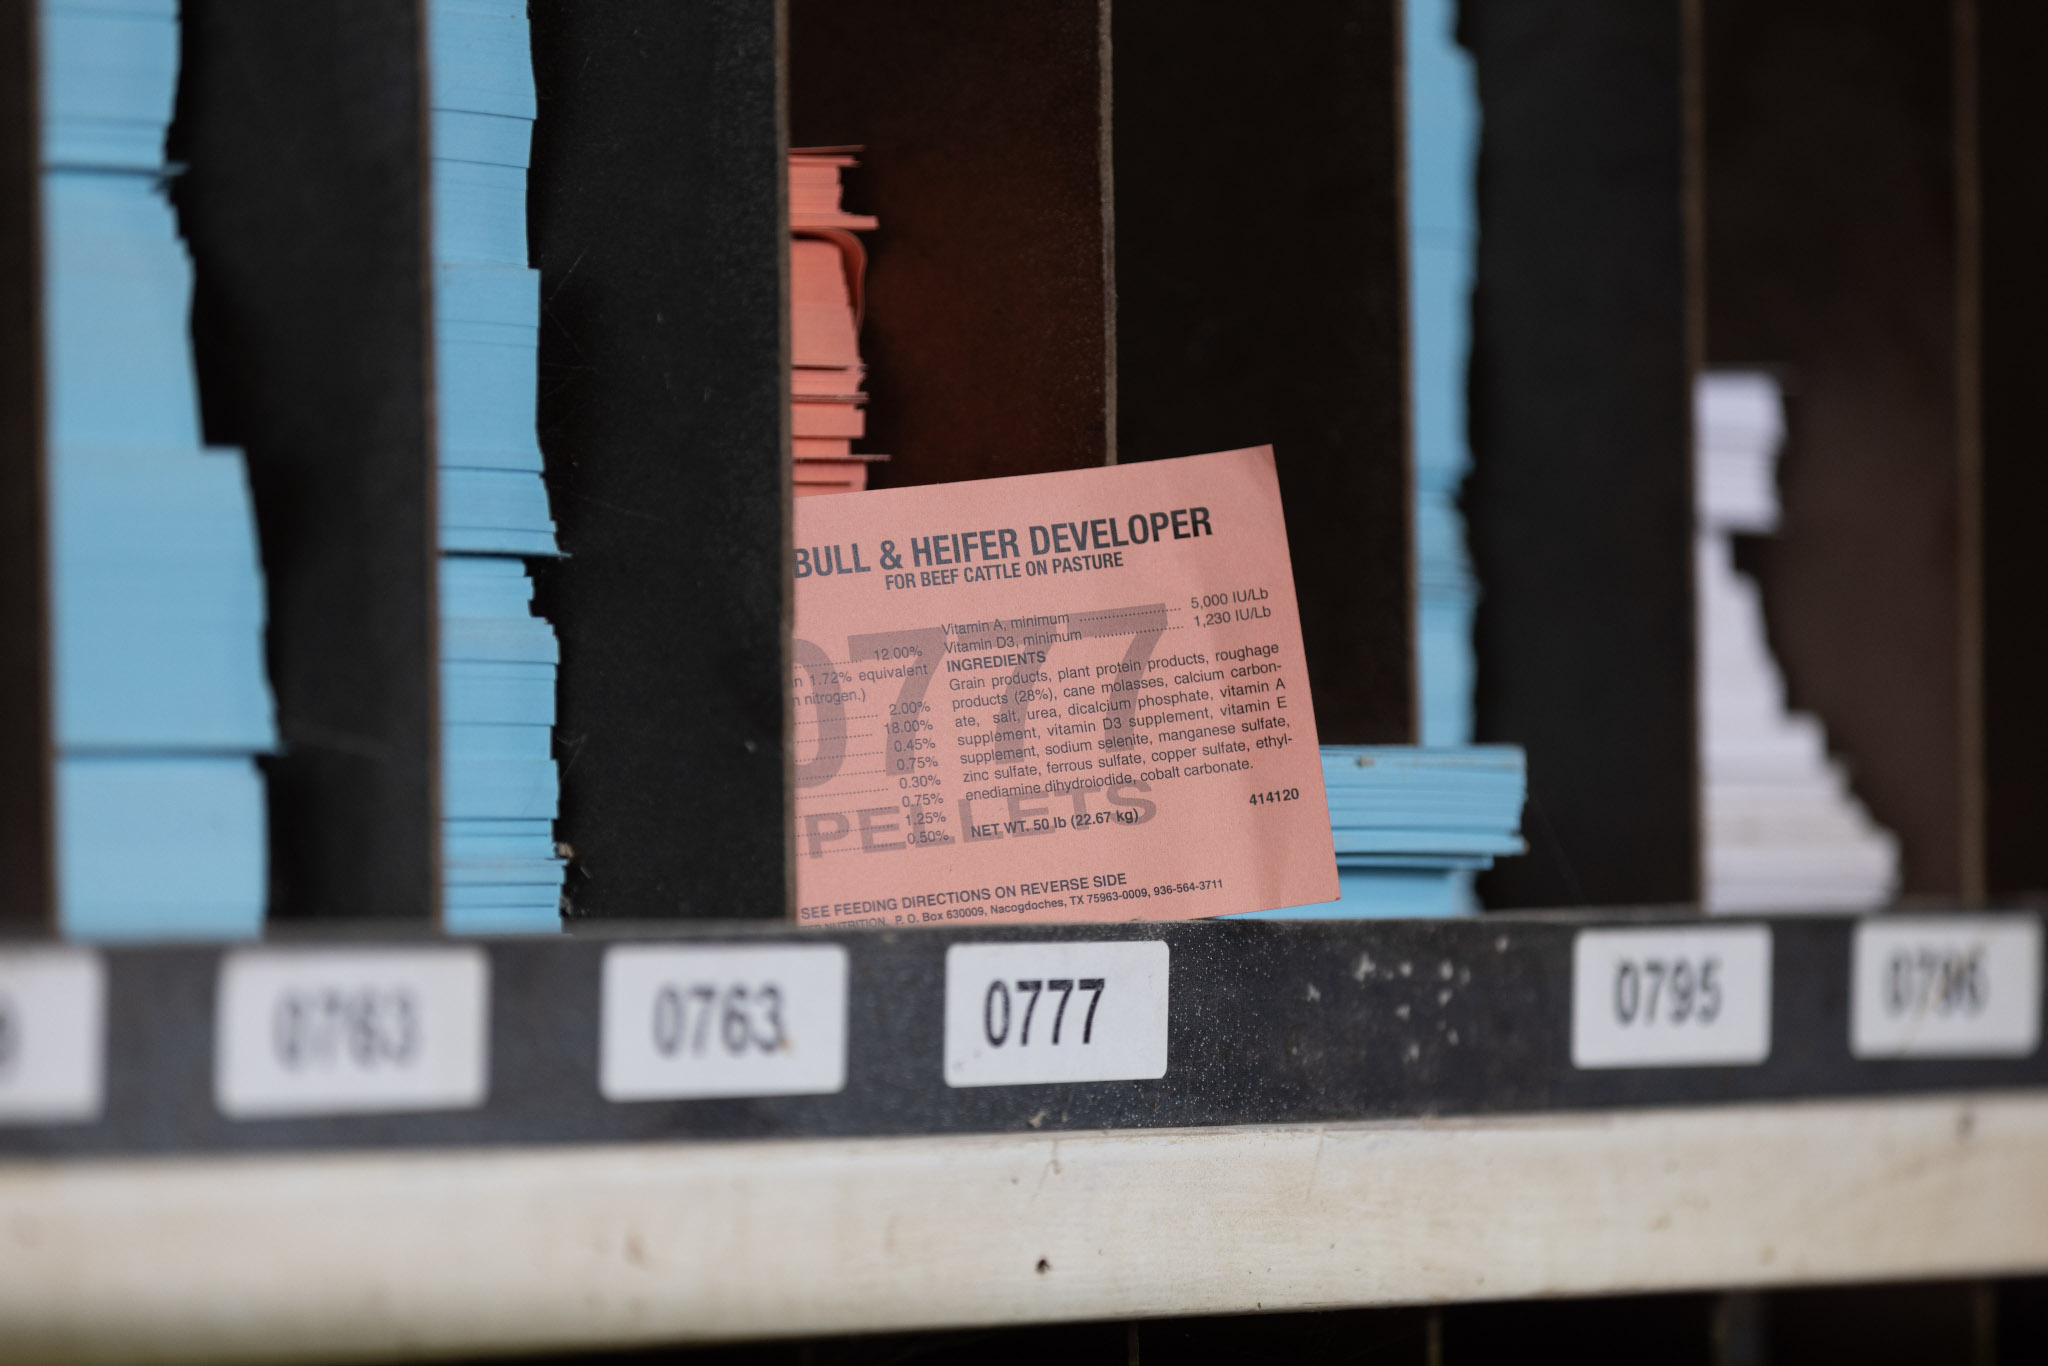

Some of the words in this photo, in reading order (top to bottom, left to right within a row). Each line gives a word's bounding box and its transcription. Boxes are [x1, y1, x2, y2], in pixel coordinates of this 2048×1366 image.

[794, 543, 871, 578] BULL
[879, 540, 902, 570] &
[911, 528, 1020, 567] HEIFER
[1029, 506, 1213, 557] DEVELOPER
[885, 574, 916, 590] FOR
[921, 569, 959, 587] BEEF
[964, 562, 1021, 582] CATTLE
[1025, 561, 1048, 577] ON
[1052, 552, 1124, 574] PASTURE
[942, 622, 990, 636] Vitamin
[993, 619, 1007, 631] A,
[1011, 614, 1070, 628] minimum
[1190, 593, 1228, 609] 5,000
[1232, 588, 1269, 604] IU/Lb
[945, 639, 993, 654] Vitamin
[996, 637, 1019, 650] D3,
[1023, 630, 1082, 645] minimum
[1194, 613, 1231, 628] 1,230
[1235, 607, 1272, 622] IU/Lb
[810, 672, 852, 684] 1.72%
[858, 664, 928, 683] equivalent
[873, 646, 923, 660] 12.00%
[947, 651, 1046, 672] INGREDIENTS
[949, 677, 985, 691] Grain
[991, 671, 1052, 690] products,
[1058, 665, 1091, 682] plant
[1096, 659, 1142, 677] protein
[1148, 652, 1209, 672] products,
[1215, 644, 1279, 661] roughage
[804, 689, 867, 706] nitrogen.)
[952, 695, 1008, 712] products
[1014, 690, 1057, 706] (28%),
[1063, 686, 1095, 698] cane
[1101, 677, 1168, 692] molasses,
[1174, 669, 1225, 684] calcium
[1230, 663, 1282, 678] carbon-
[955, 715, 980, 728] ate,
[993, 710, 1020, 724] salt,
[1028, 708, 1061, 721] urea,
[1068, 697, 1131, 716] dicalcium
[1138, 690, 1213, 710] phosphate,
[1220, 683, 1269, 698] vitamin
[1275, 678, 1286, 689] A
[884, 720, 934, 735] 18.00%
[889, 702, 931, 716] 2.00%
[958, 728, 1041, 748] supplement,
[1047, 718, 1096, 736] vitamin
[1103, 718, 1122, 730] D3
[1129, 708, 1213, 728] supplement,
[1220, 701, 1270, 717] vitamin
[1277, 696, 1288, 708] E
[894, 739, 936, 753] 0.45%
[960, 746, 1040, 766] supplement,
[1045, 741, 1092, 755] sodium
[1098, 734, 1153, 750] selenite,
[1159, 725, 1235, 743] manganese
[1242, 717, 1290, 732] sulfate,
[963, 771, 989, 783] zinc
[994, 764, 1042, 780] sulfate,
[1047, 759, 1092, 773] ferrous
[1098, 752, 1146, 768] sulfate,
[1151, 748, 1196, 764] copper
[1202, 741, 1250, 757] sulfate,
[1256, 734, 1293, 750] ethyl-
[896, 757, 939, 771] 0.75%
[899, 775, 941, 789] 0.30%
[966, 783, 1041, 802] enediamine
[1045, 772, 1137, 793] dihydroiodide,
[1140, 765, 1181, 782] cobalt
[1184, 760, 1254, 777] carbonate.
[902, 793, 944, 808] 0.75%
[1249, 788, 1300, 806] 414120
[804, 779, 1157, 859] PELLETS
[906, 812, 947, 826] 1.25%
[907, 830, 949, 845] 0.50%
[971, 823, 1000, 838] NET
[1004, 820, 1030, 834] WT.
[1034, 818, 1050, 831] 50
[1053, 816, 1067, 828] lb
[1071, 812, 1111, 829] (22.67
[1116, 808, 1138, 823] kg)
[801, 906, 831, 920] SEE
[834, 898, 897, 916] FEEDING
[902, 888, 991, 909] DIRECTIONS
[995, 886, 1016, 898] ON
[1020, 877, 1089, 895] REVERSE
[1093, 873, 1127, 888] SIDE
[895, 914, 905, 924] P.
[907, 913, 920, 922] O.
[922, 909, 944, 922] Box
[946, 906, 988, 919] 630009,
[990, 897, 1067, 915] Nacogdoches,
[1070, 895, 1085, 906] TX
[1087, 888, 1151, 904] 75963-0009,
[1153, 879, 1223, 896] 936-564-3711
[984, 978, 1106, 1048] 0777
[1612, 958, 1723, 1027] 0795
[653, 983, 787, 1057] 0763
